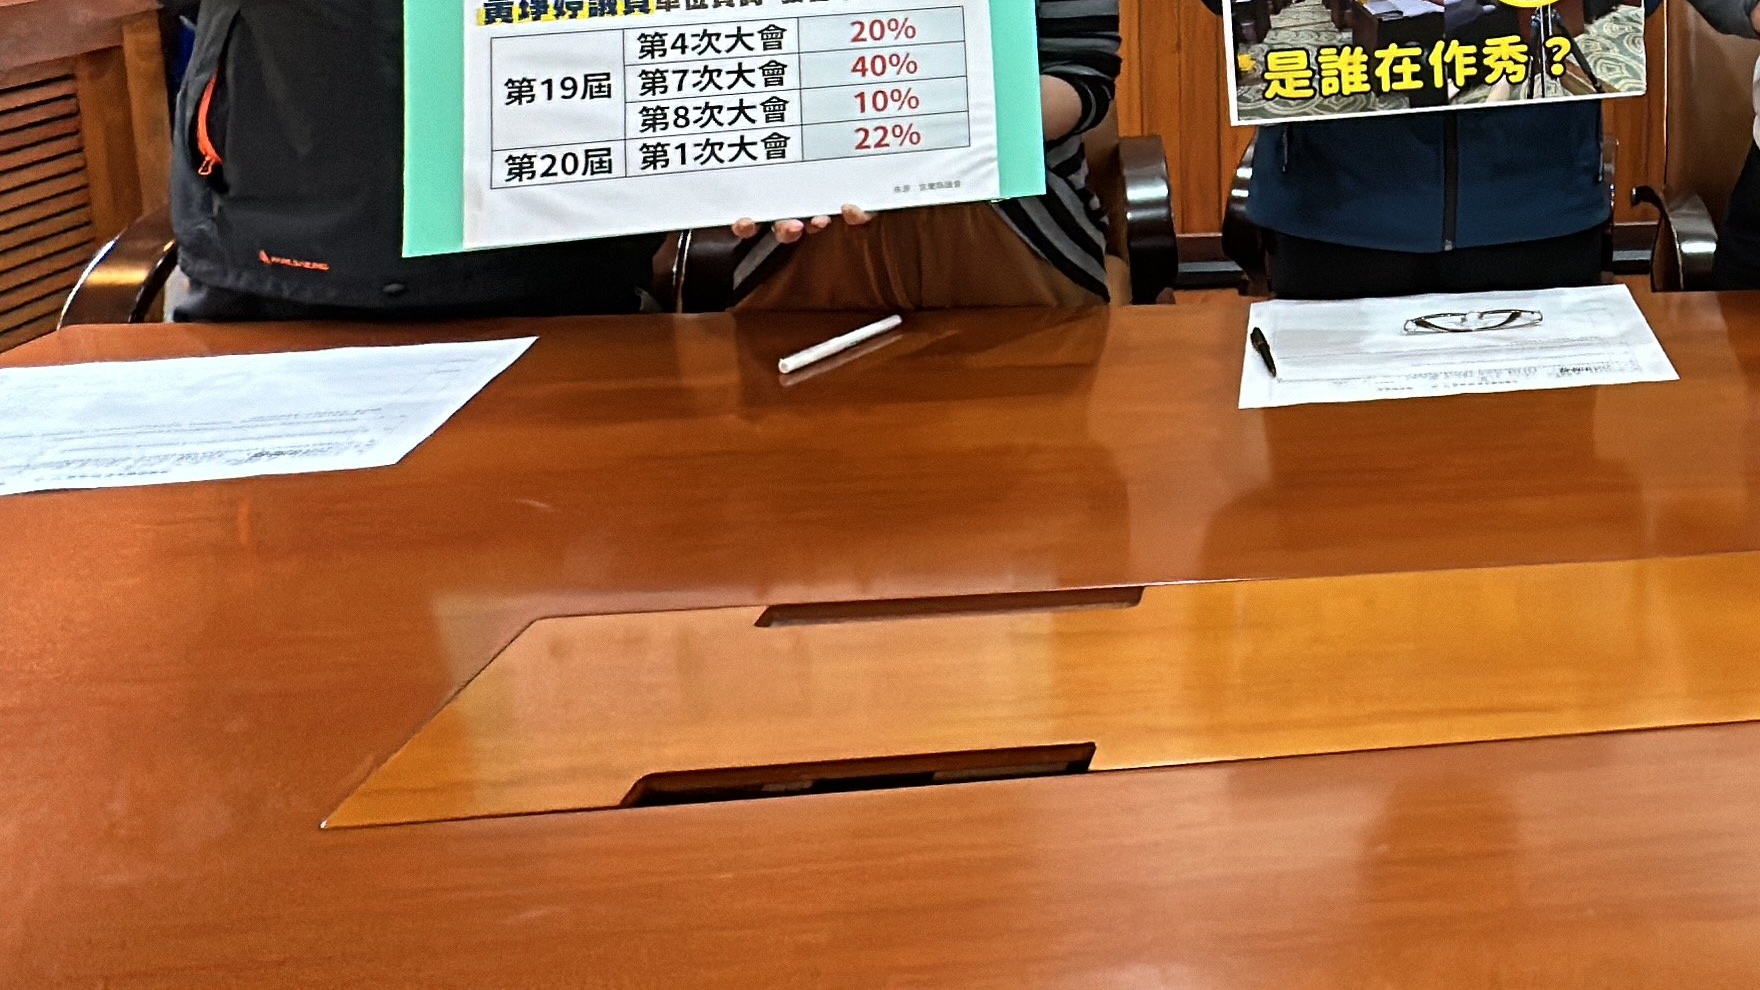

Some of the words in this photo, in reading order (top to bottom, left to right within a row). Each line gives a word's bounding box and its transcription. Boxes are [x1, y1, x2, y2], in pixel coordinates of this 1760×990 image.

[637, 23, 789, 60] 第4次大會
[850, 17, 917, 43] 20%
[503, 71, 613, 106] 第19屆
[638, 59, 789, 97] 第7次大會
[851, 52, 918, 78] 40%
[1263, 33, 1574, 101] 是誰在作秀？
[638, 95, 790, 133] 第8次大會
[854, 87, 920, 113] 10%
[504, 147, 613, 184] 第20屆
[639, 131, 792, 171] 第1次大會
[854, 123, 922, 150] 22%
